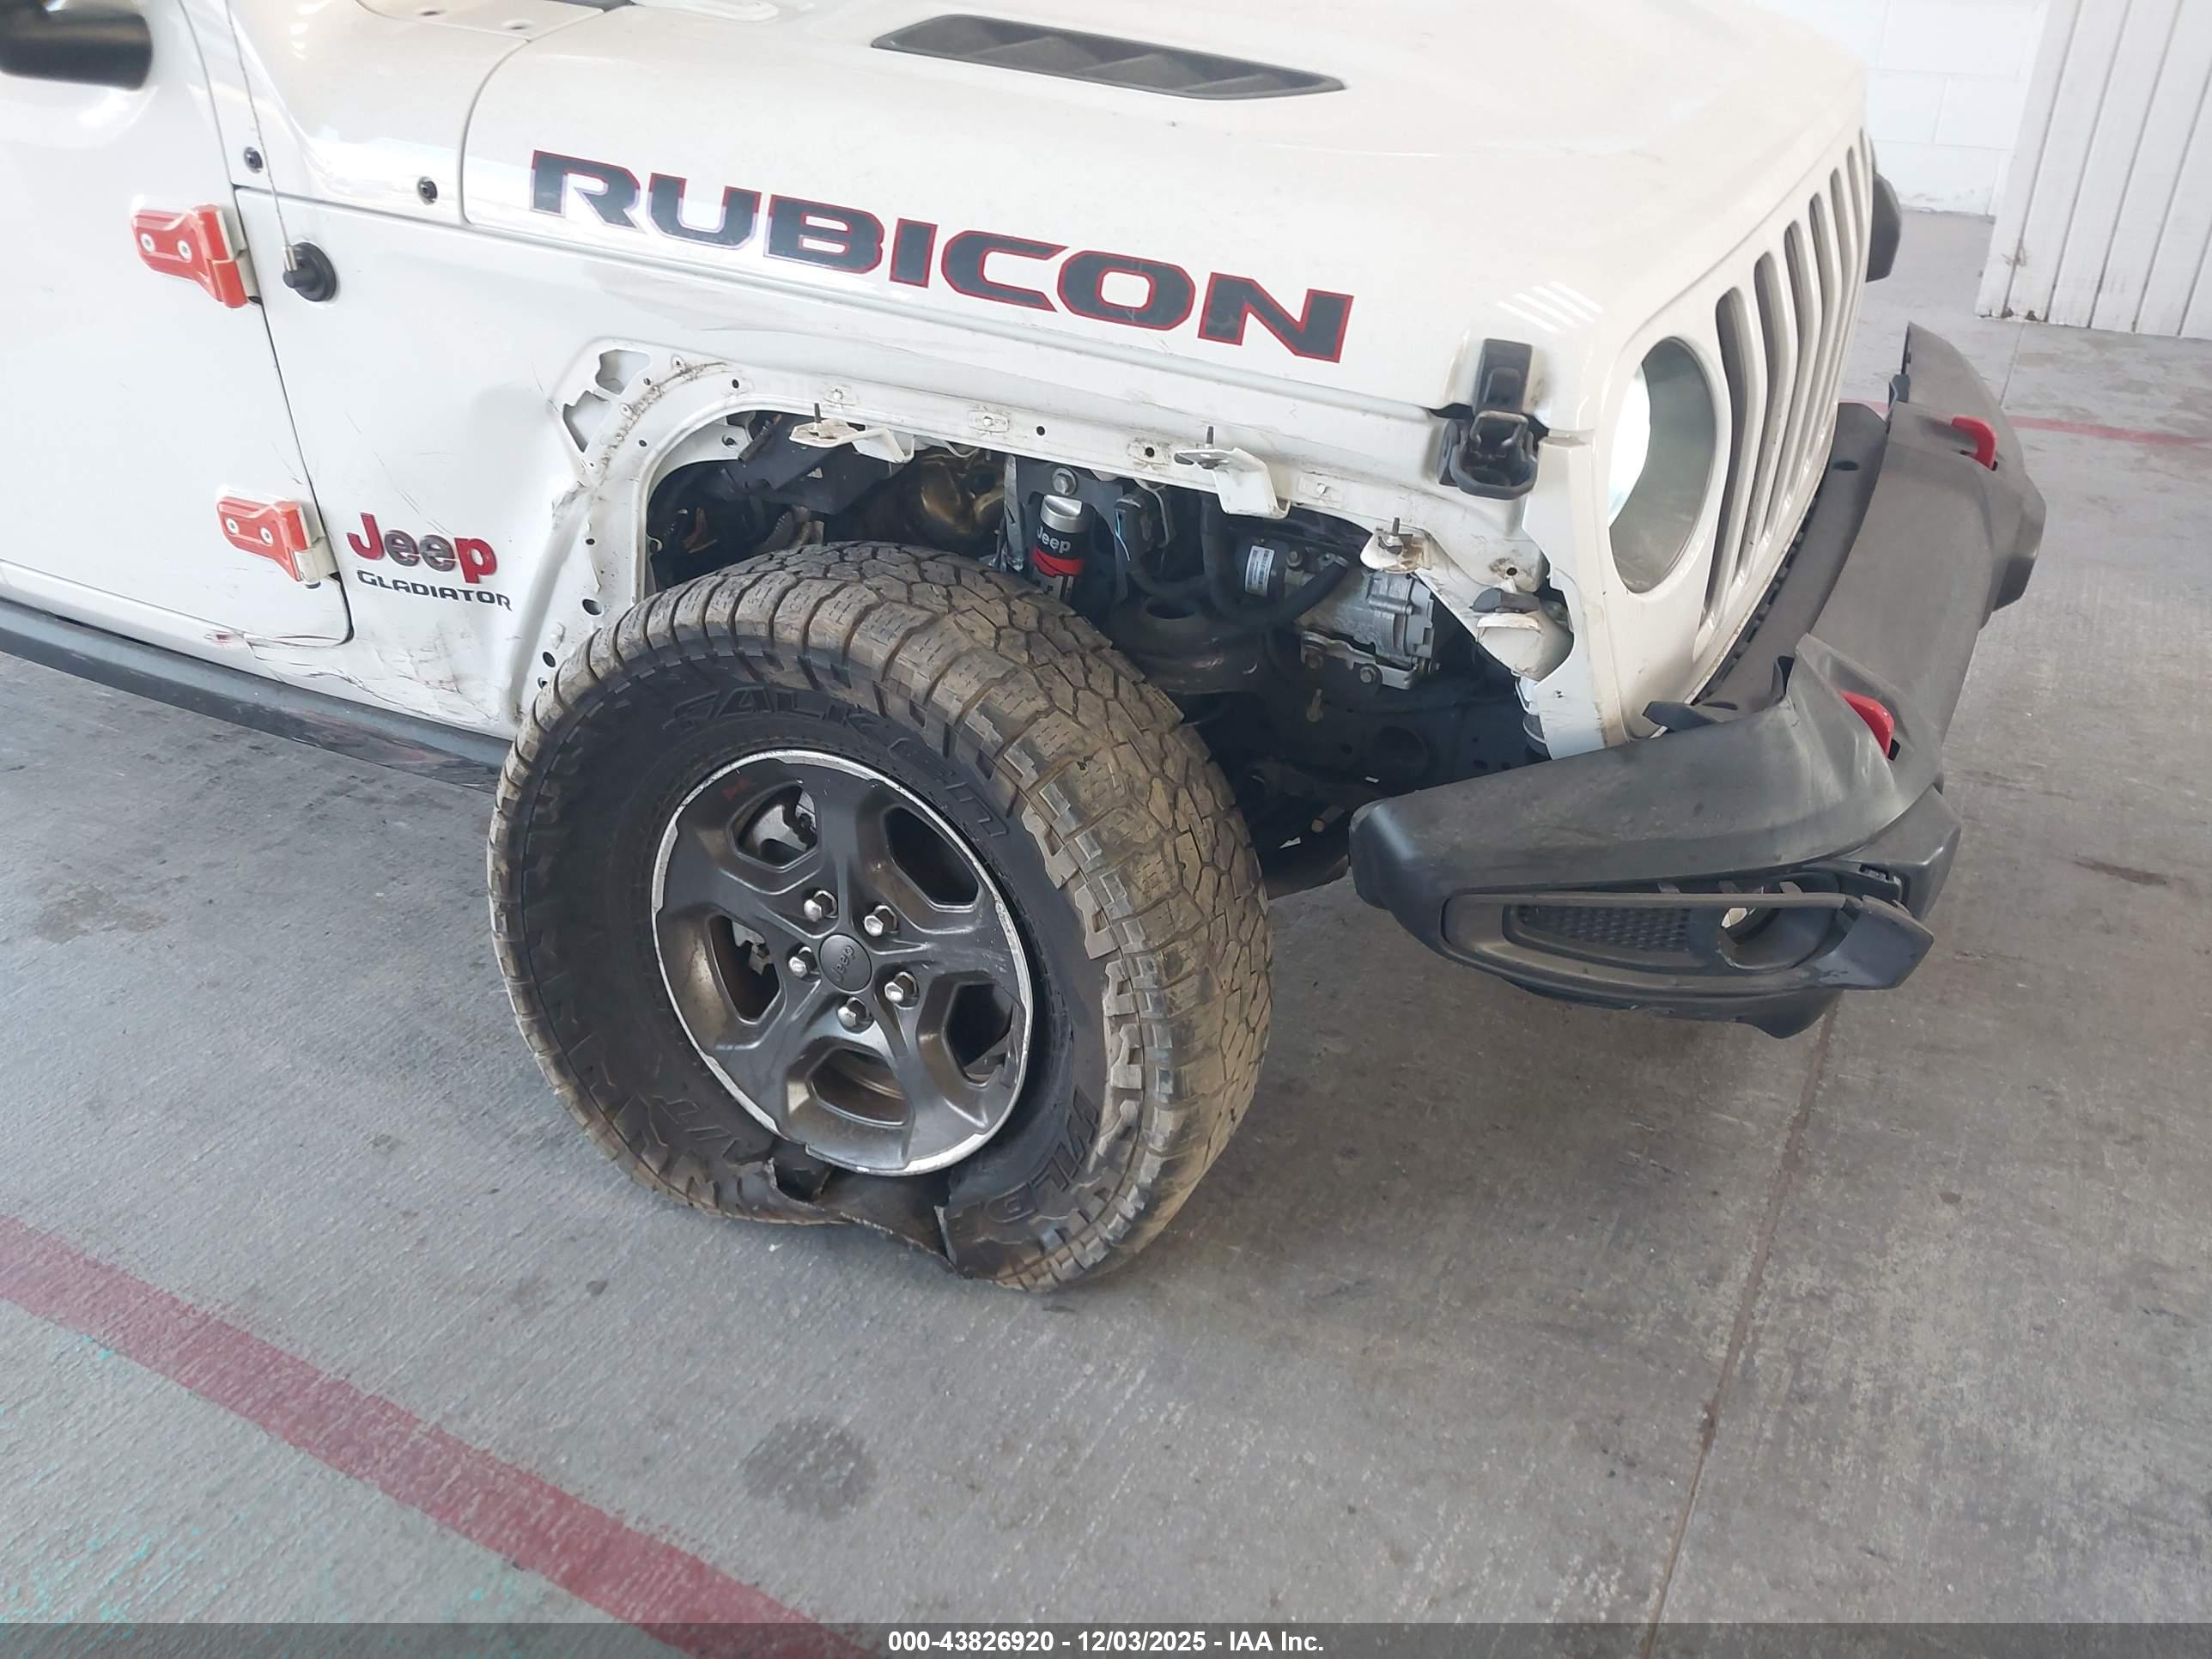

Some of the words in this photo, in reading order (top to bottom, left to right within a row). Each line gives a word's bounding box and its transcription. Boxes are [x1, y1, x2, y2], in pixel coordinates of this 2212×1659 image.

[530, 149, 1354, 362] RUBICON
[346, 512, 497, 584] Jeep
[1036, 526, 1072, 554] Jeep
[356, 569, 513, 611] GLADIATOR
[831, 945, 857, 982] Jeep
